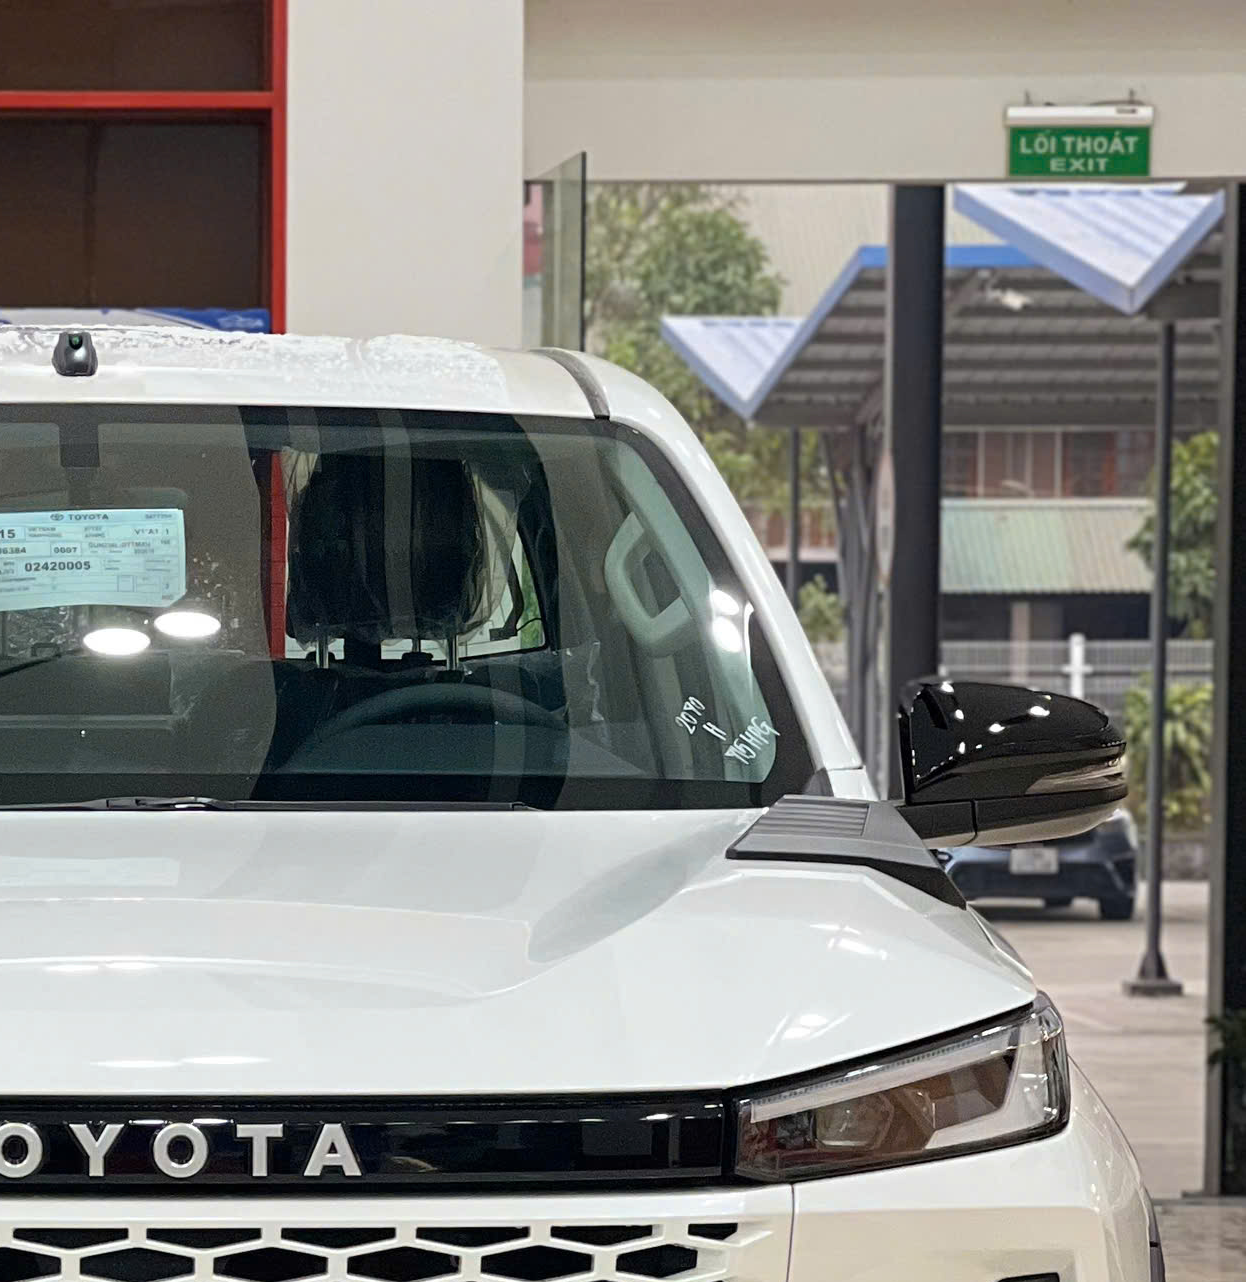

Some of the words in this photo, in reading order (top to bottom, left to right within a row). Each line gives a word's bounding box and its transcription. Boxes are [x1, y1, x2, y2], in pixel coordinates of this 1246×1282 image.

[1019, 130, 1056, 154] LỐI
[1062, 131, 1138, 154] THOÁT
[1049, 157, 1109, 172] EXIT
[24, 560, 91, 573] 02420005
[674, 696, 705, 735] 2090
